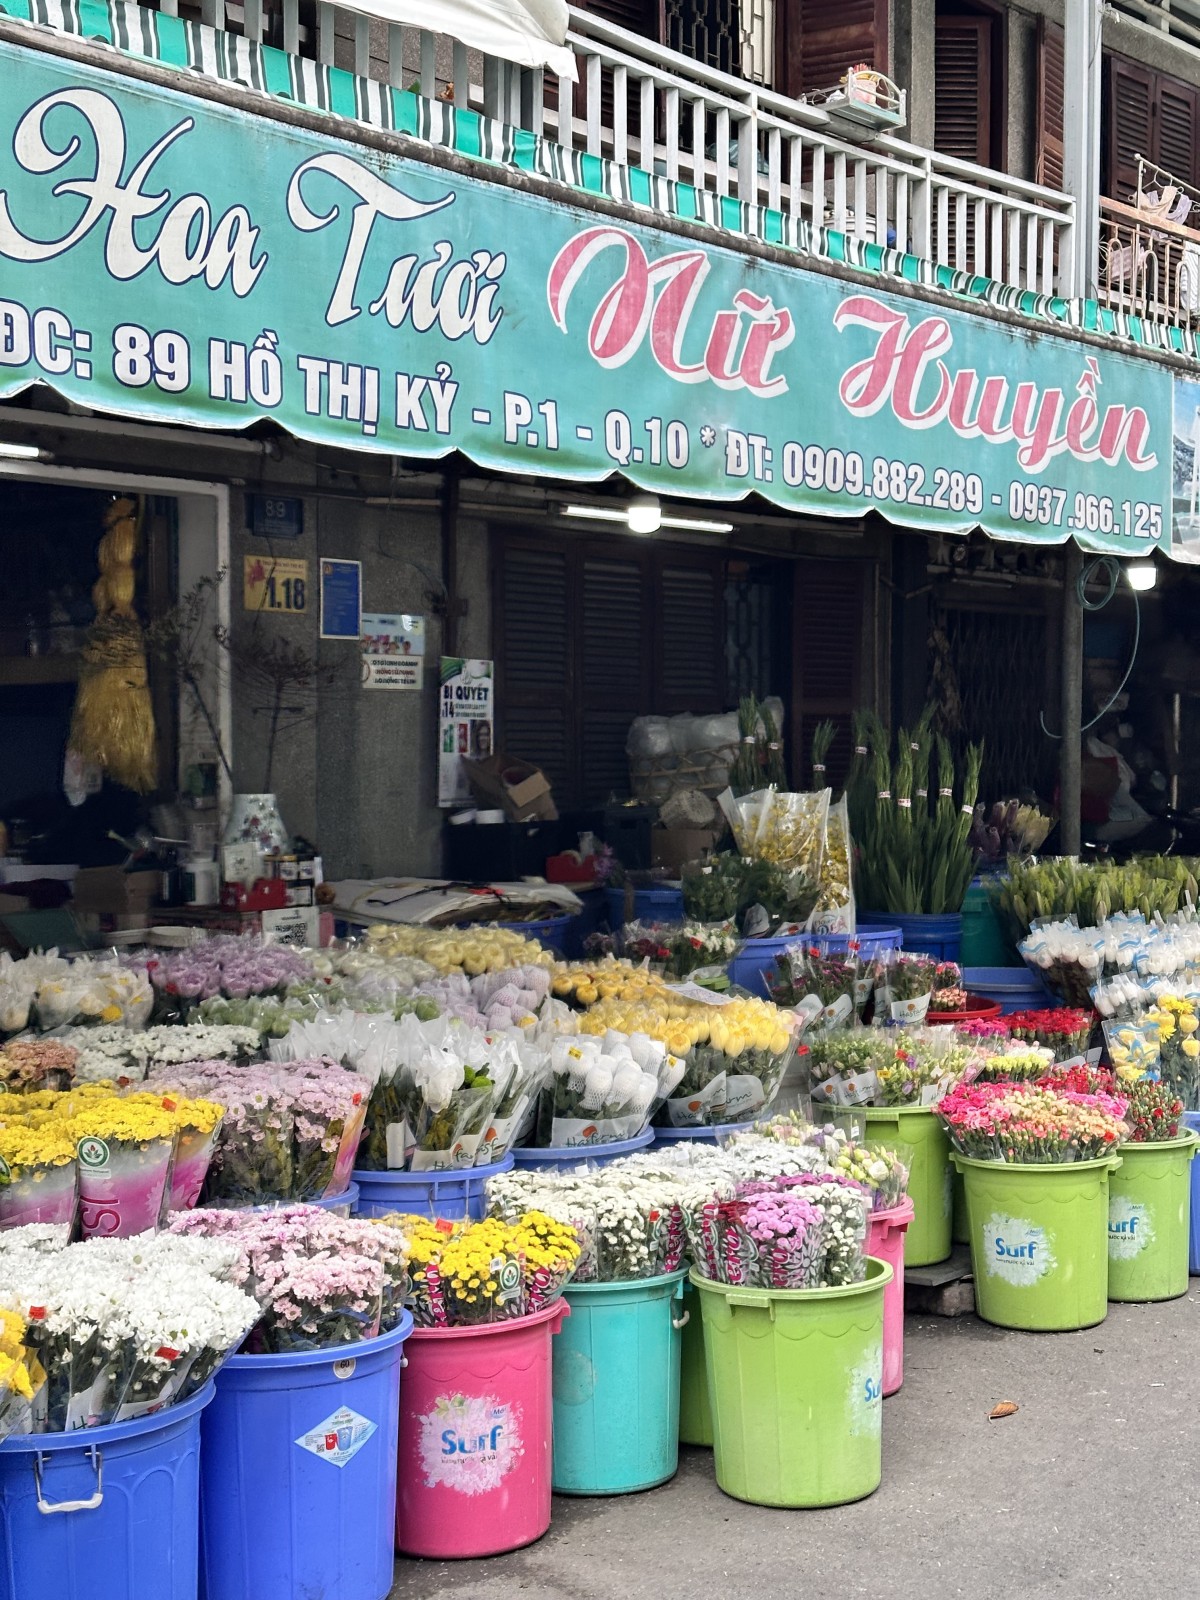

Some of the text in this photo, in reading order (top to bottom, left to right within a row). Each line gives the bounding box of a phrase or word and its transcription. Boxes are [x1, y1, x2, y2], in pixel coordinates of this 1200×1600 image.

[0, 86, 1158, 475] Hoa Tươi Nữ Huyền
[0, 299, 93, 381] ĐC:
[112, 323, 191, 394] 89
[208, 330, 284, 408] HỒ
[299, 356, 380, 436] THỊ
[396, 362, 459, 434] KỶ
[504, 393, 560, 452] P.1
[604, 408, 690, 470] Q.10
[724, 429, 774, 484] ĐT:
[783, 441, 984, 515] 0909.882.289
[1007, 480, 1164, 541] 0937.966.125
[265, 501, 286, 517] 89
[1108, 1216, 1140, 1234] urf
[995, 1237, 1038, 1259] Surf
[441, 1425, 503, 1455] Surf
